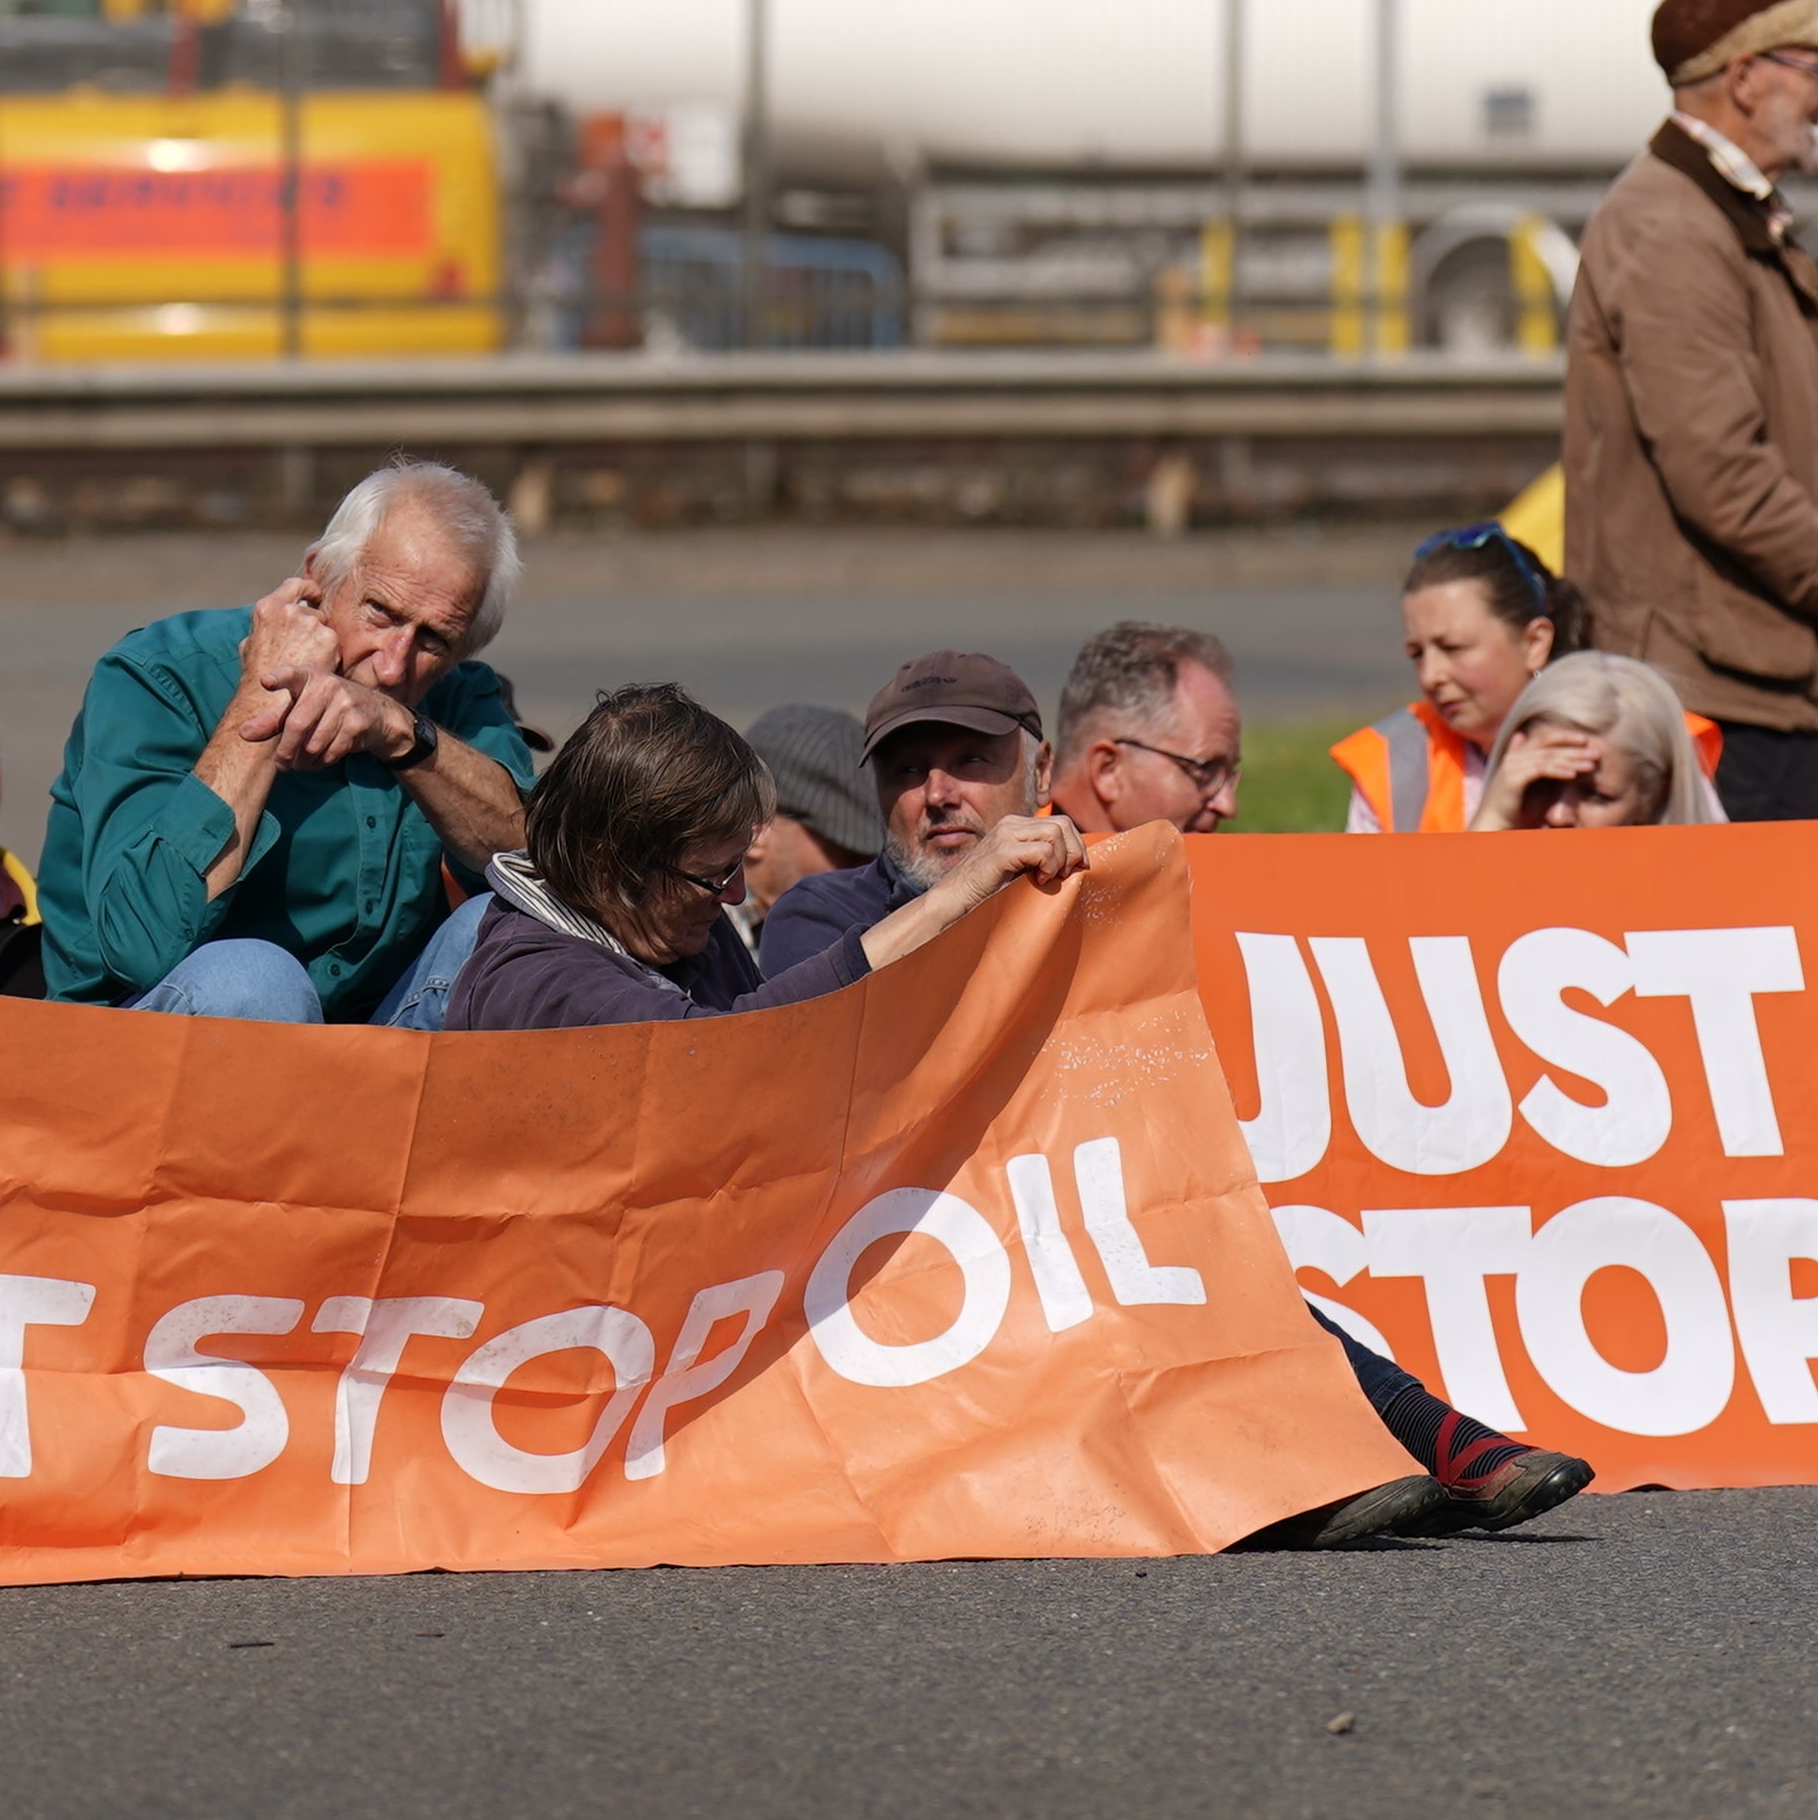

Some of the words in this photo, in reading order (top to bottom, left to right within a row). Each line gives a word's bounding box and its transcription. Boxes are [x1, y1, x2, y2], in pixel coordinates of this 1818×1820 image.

[1235, 925, 1806, 1183] JUST
[144, 1269, 787, 1496] STOP
[803, 1134, 1208, 1389] OIL
